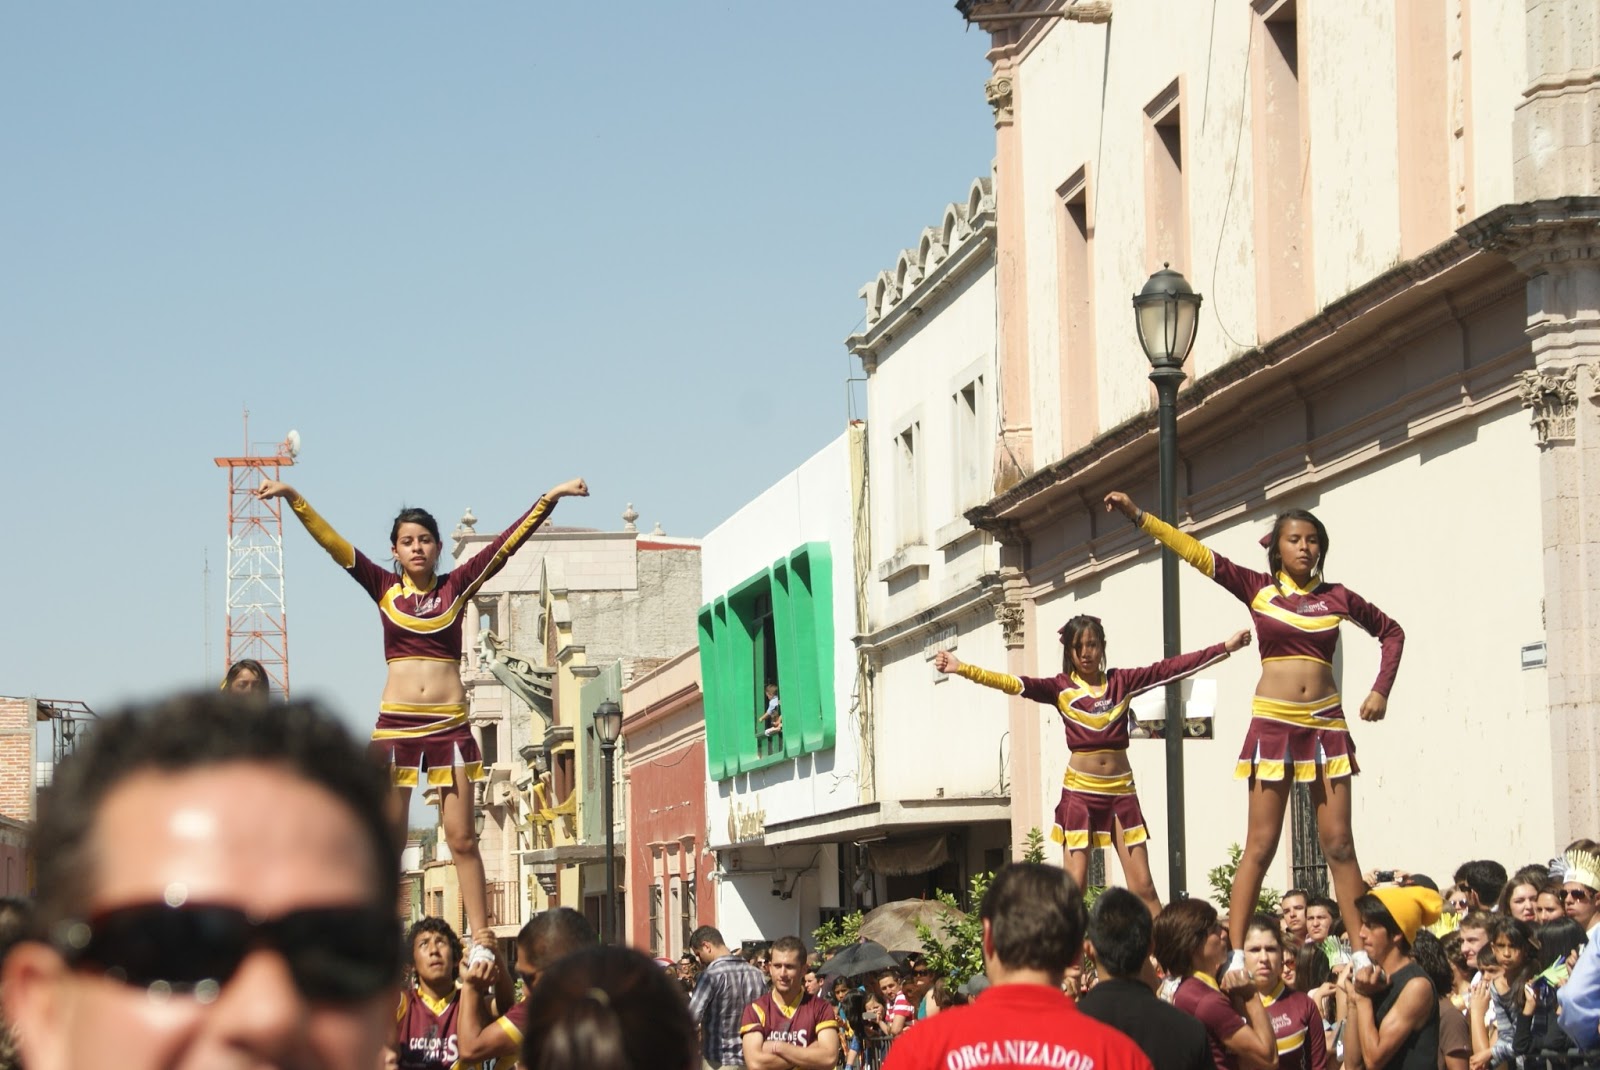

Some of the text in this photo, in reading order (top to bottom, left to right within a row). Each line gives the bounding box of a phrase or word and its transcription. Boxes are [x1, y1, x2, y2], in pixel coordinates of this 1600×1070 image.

[410, 1034, 459, 1057] CICLONES
[767, 1028, 808, 1045] ICLONES
[946, 1039, 1094, 1070] ORGANIZADOR
